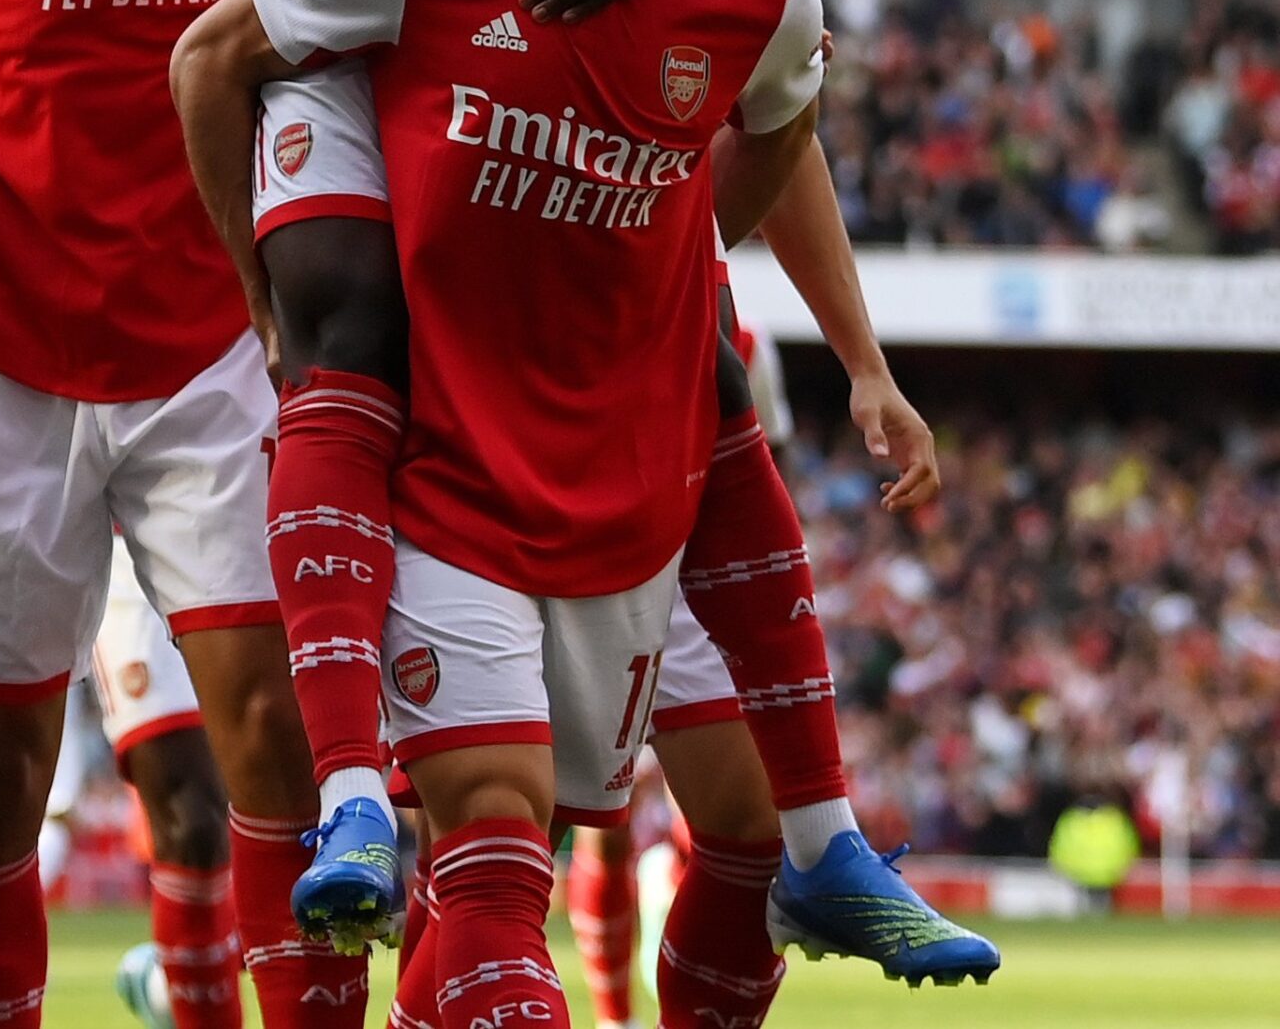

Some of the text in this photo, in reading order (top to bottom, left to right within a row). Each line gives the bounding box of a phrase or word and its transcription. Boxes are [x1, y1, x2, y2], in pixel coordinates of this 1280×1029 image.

[472, 33, 528, 52] adidas
[668, 57, 705, 72] Arsenal
[447, 84, 696, 187] Emirates
[471, 161, 661, 229] FLY BETTER
[294, 555, 373, 583] AFC
[789, 593, 817, 620] A
